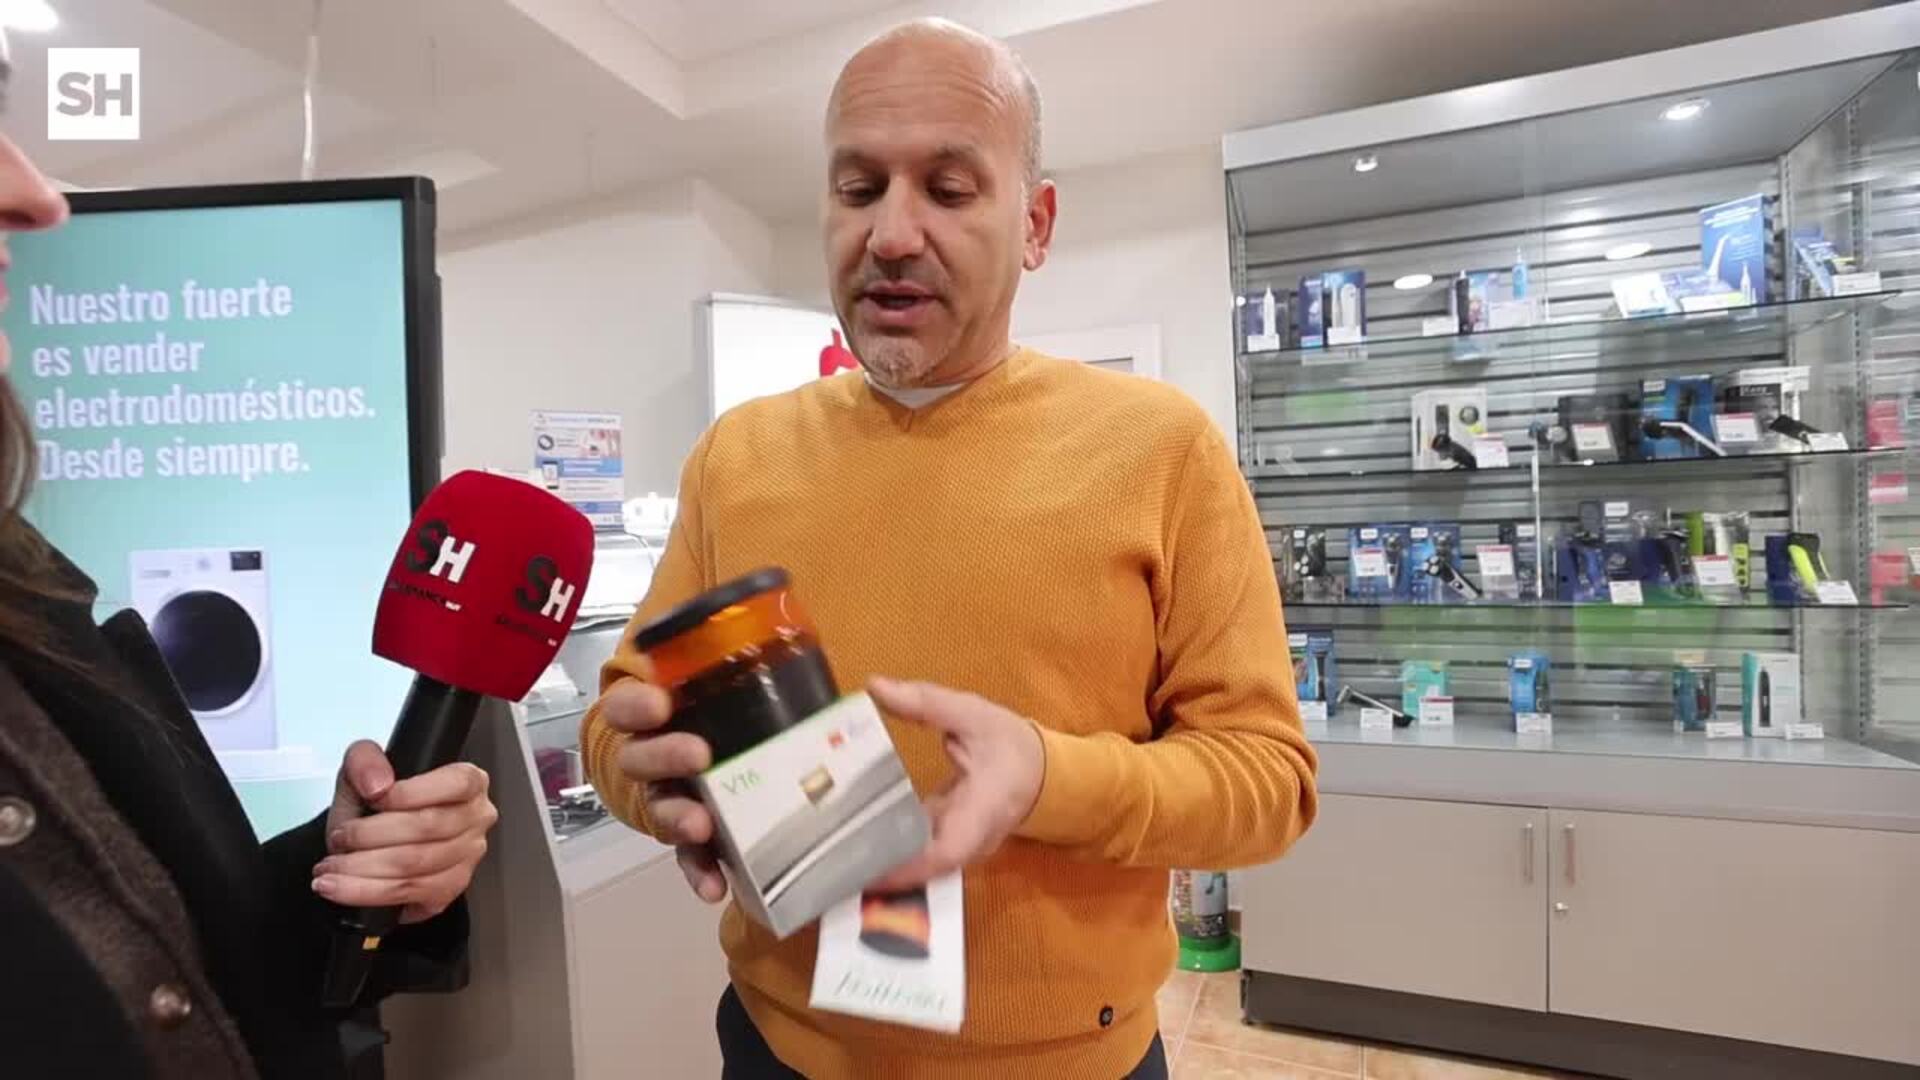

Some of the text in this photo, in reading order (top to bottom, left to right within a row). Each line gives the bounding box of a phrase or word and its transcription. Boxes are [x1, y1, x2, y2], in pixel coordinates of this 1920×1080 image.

[30, 279, 293, 325] Nuestro fuerte
[32, 332, 205, 377] es vender
[36, 379, 376, 429] electrodomésticos.
[38, 437, 311, 483] Desde siempre.
[406, 519, 477, 584] SH
[515, 554, 576, 623] SH
